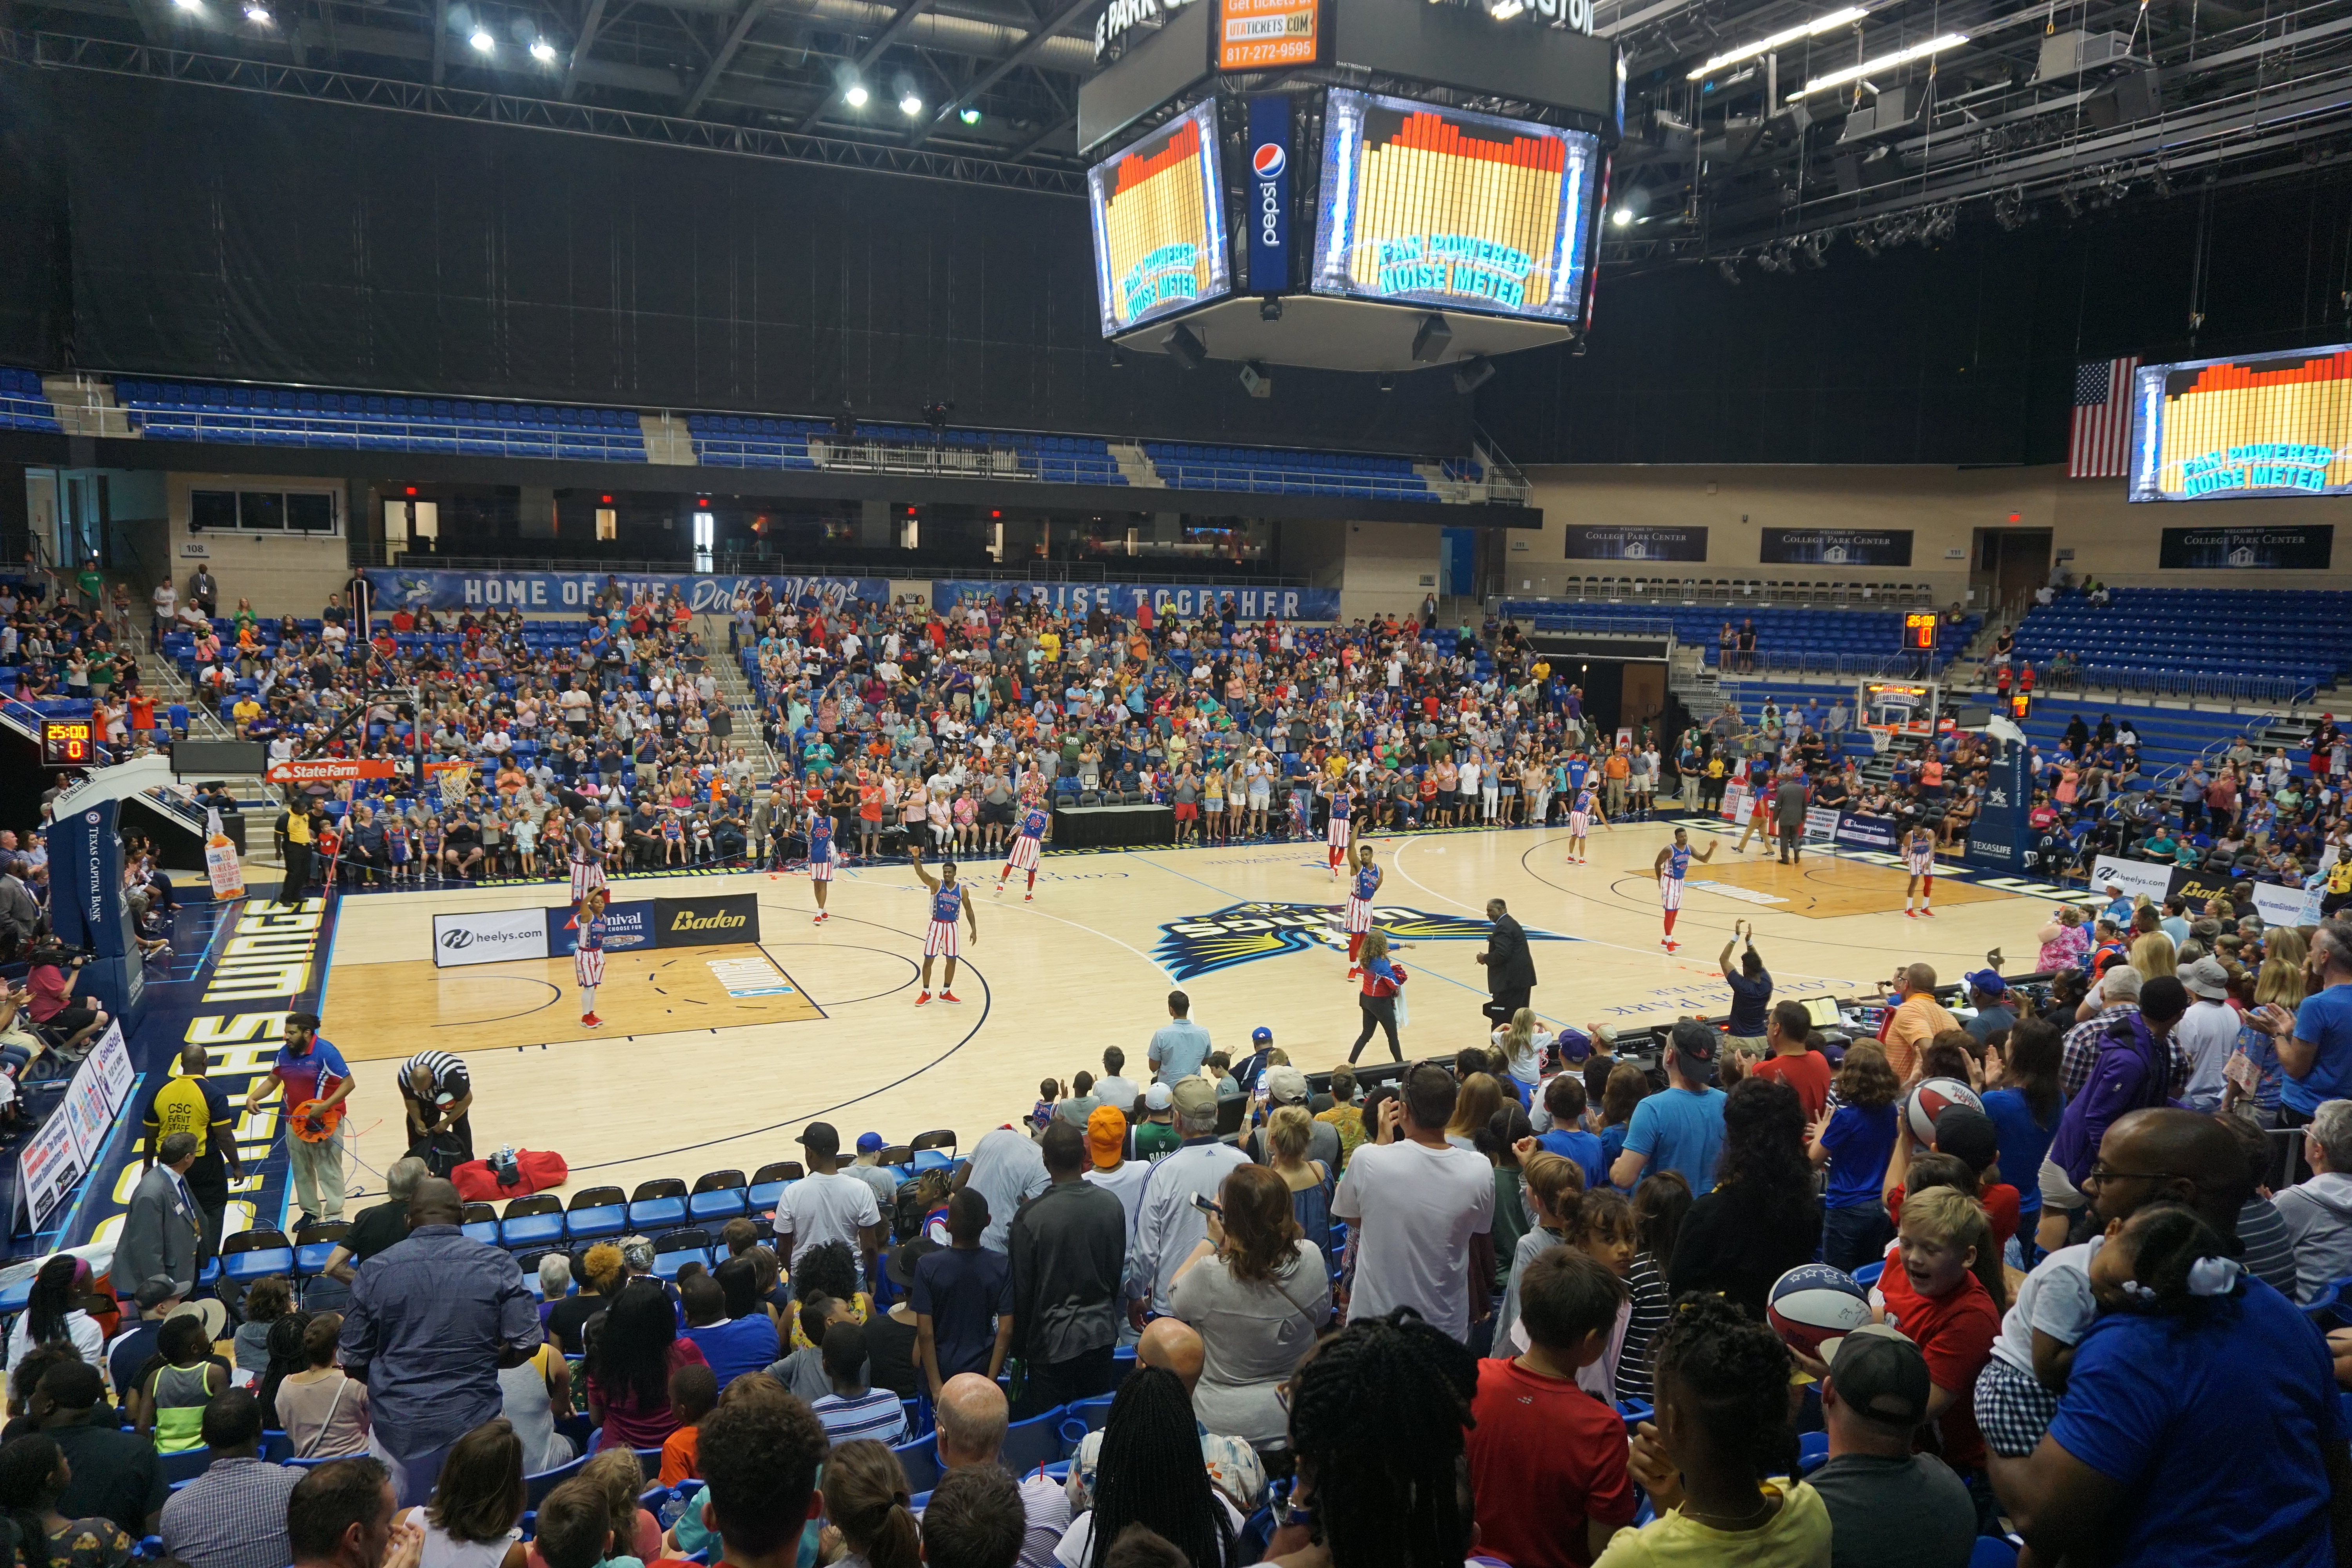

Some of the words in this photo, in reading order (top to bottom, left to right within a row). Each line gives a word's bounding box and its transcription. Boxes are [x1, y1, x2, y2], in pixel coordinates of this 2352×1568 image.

[1227, 41, 1311, 62] 817-272-9595
[1336, 61, 1372, 71] DAKTRONICS
[1262, 179, 1279, 247] pepsi
[1378, 234, 1421, 265] FAN
[1430, 233, 1532, 278] POWERED
[1122, 261, 1143, 299] FAN
[1143, 241, 1196, 273] POWERED
[1312, 288, 1347, 297] DAKTRONICS
[1379, 263, 1446, 294] NOISE
[1453, 266, 1525, 309] METER
[1126, 280, 1157, 323] NOISE
[1158, 273, 1197, 299] METER
[2181, 450, 2222, 478] FAN
[2227, 443, 2332, 466] POWERED
[2183, 468, 2245, 498] NOISE
[2250, 466, 2326, 491] METER
[1586, 531, 1624, 540] COLLEGE
[1627, 532, 1650, 541] PARK
[1652, 532, 1687, 541] CENTER
[1783, 535, 1824, 544] COLLEGE
[1827, 535, 1851, 544] PARK
[1853, 536, 1891, 545] CENTER
[2184, 534, 2230, 545] COLLEGE
[2232, 534, 2259, 544] PARK
[2262, 534, 2306, 544] CENTER
[186, 544, 203, 553] 108
[465, 579, 548, 604] HOME
[562, 581, 596, 605] OF
[1033, 586, 1111, 614] RISE
[1132, 589, 1299, 617] TOGETHER
[1909, 615, 1935, 626] 25:00
[1922, 627, 1933, 645] 0
[1875, 694, 1919, 706] GLOBETROTTERS
[2015, 696, 2028, 704] 25:00
[2020, 705, 2026, 714] 0
[48, 725, 89, 740] 25:00
[1939, 721, 1953, 730] eFarm
[68, 740, 82, 758] 0
[292, 764, 359, 779] StateFarm
[60, 775, 96, 802] SPALDING
[1336, 802, 1347, 811] 25
[1029, 817, 1042, 828] 16
[1844, 818, 1887, 833] Champion
[815, 827, 828, 838] 28
[89, 826, 99, 855] TEXAS
[1972, 840, 2011, 855] TEXASLIFE
[90, 857, 100, 894] CAPITAL
[475, 867, 747, 887] dallaswins.com
[2120, 873, 2166, 888] heelys.com
[91, 896, 101, 922] BANK
[607, 912, 642, 926] nival
[670, 909, 747, 931] Baden
[476, 927, 543, 943] heelys.com
[1646, 980, 1731, 996] ENTER
[1601, 998, 1707, 1016] PARK
[168, 1103, 191, 1114] CSC
[167, 1114, 191, 1123] EVENT
[167, 1123, 190, 1132] STAFF
